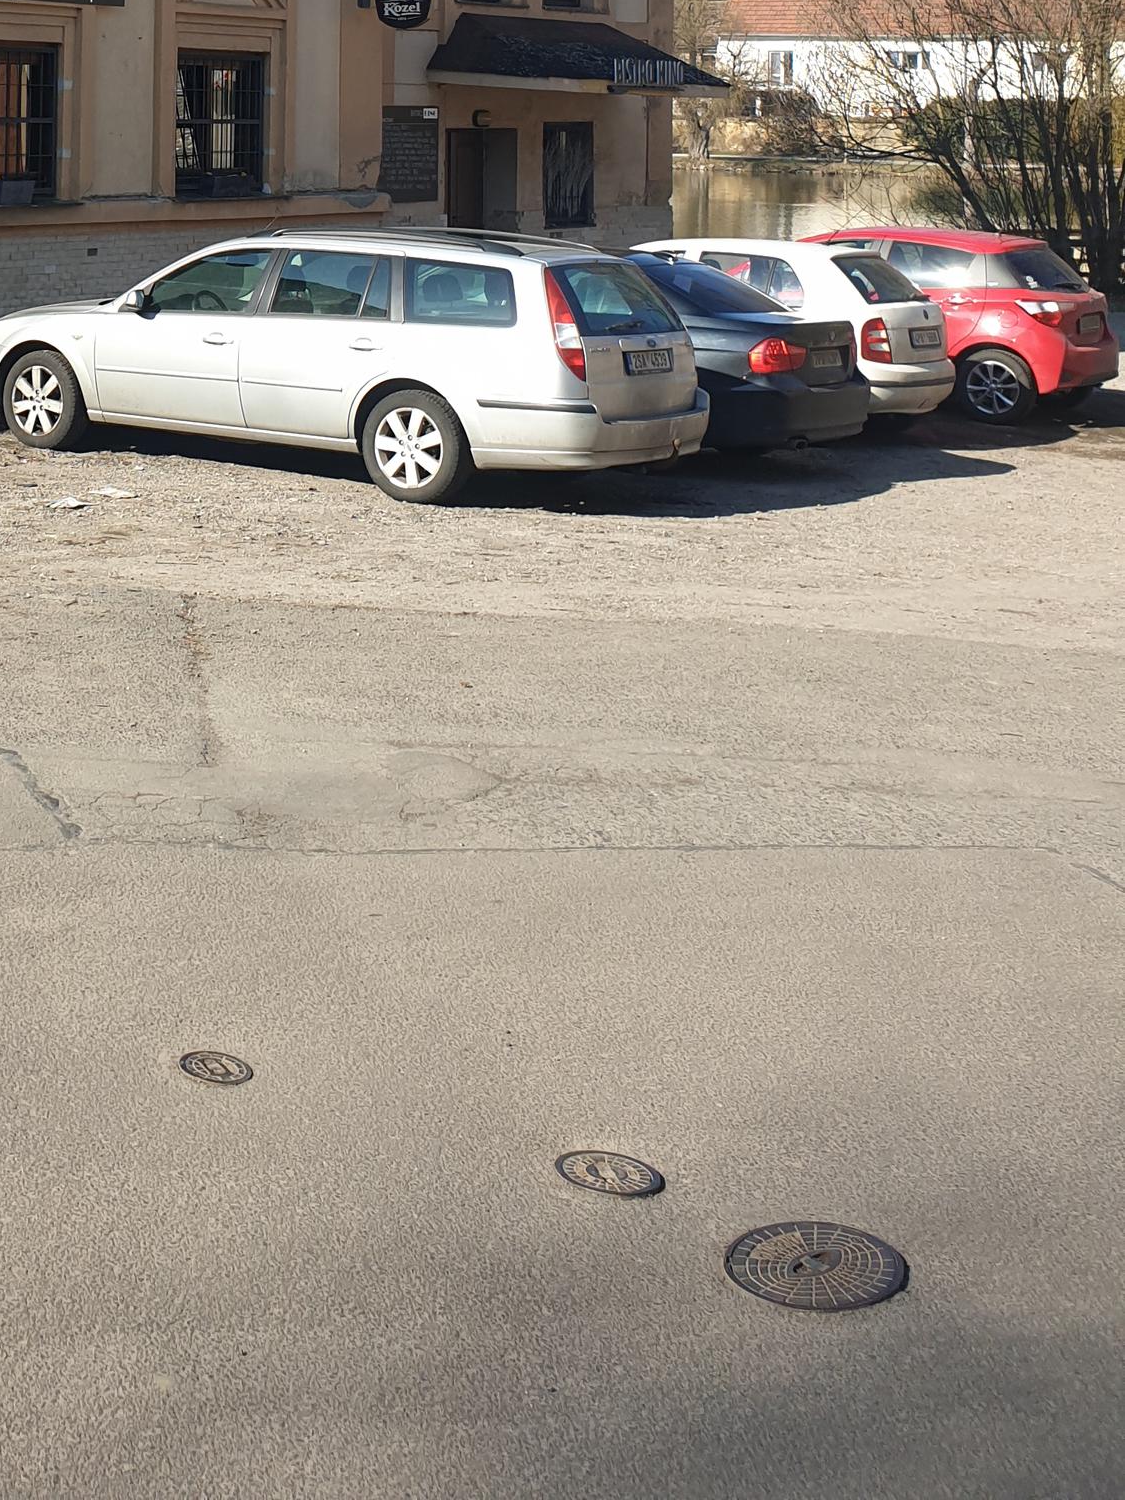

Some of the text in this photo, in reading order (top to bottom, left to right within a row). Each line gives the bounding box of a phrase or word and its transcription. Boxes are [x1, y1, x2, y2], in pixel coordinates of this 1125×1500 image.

[383, 2, 421, 17] Kozel
[613, 58, 684, 85] BISTRO KINO
